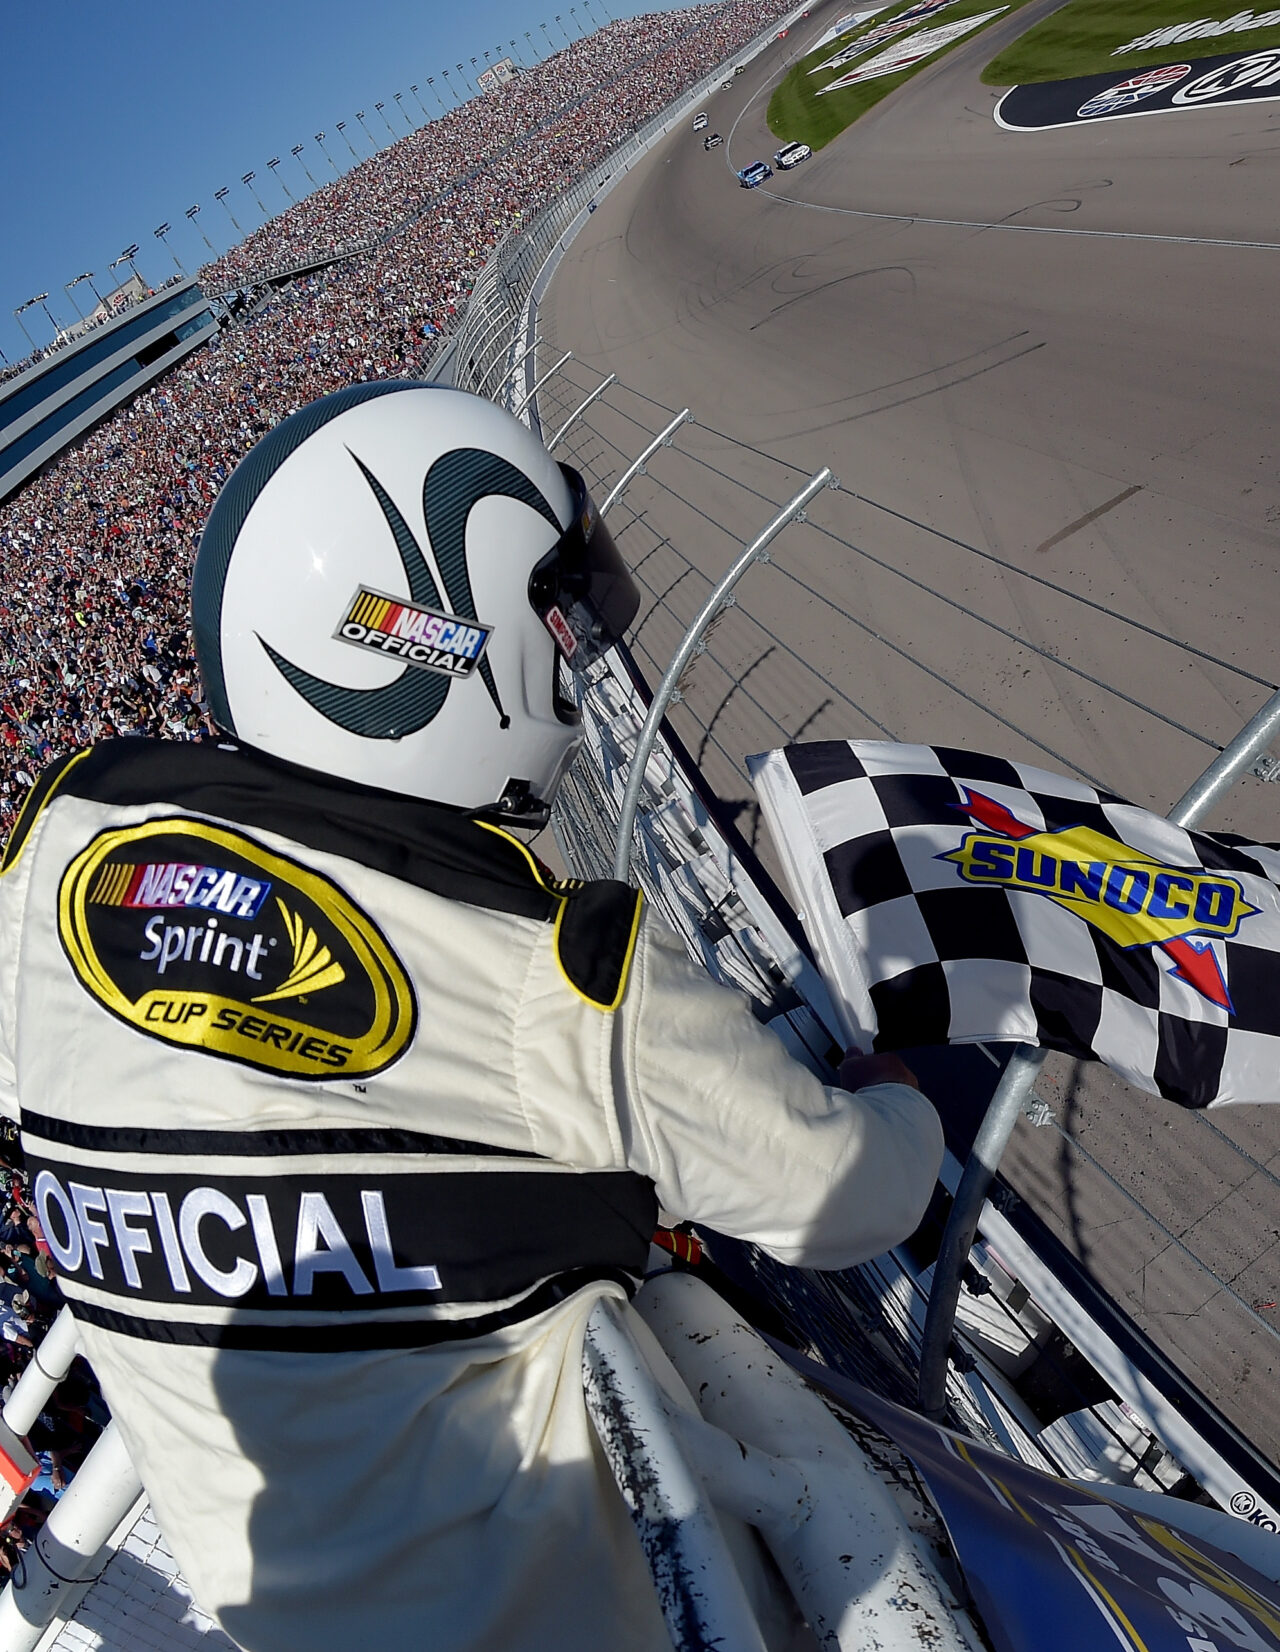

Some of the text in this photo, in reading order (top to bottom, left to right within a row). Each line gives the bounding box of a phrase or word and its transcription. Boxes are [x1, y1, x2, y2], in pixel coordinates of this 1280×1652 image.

[341, 623, 469, 674] OFFICIAL
[390, 607, 481, 659] NASCAR
[550, 609, 576, 653] SIMPSON
[135, 863, 262, 918] NASCAR
[967, 841, 1235, 927] SUNOCO
[140, 915, 269, 981] Sprint
[145, 1000, 353, 1068] CUP SERIES
[33, 1169, 442, 1297] OFFICIAL
